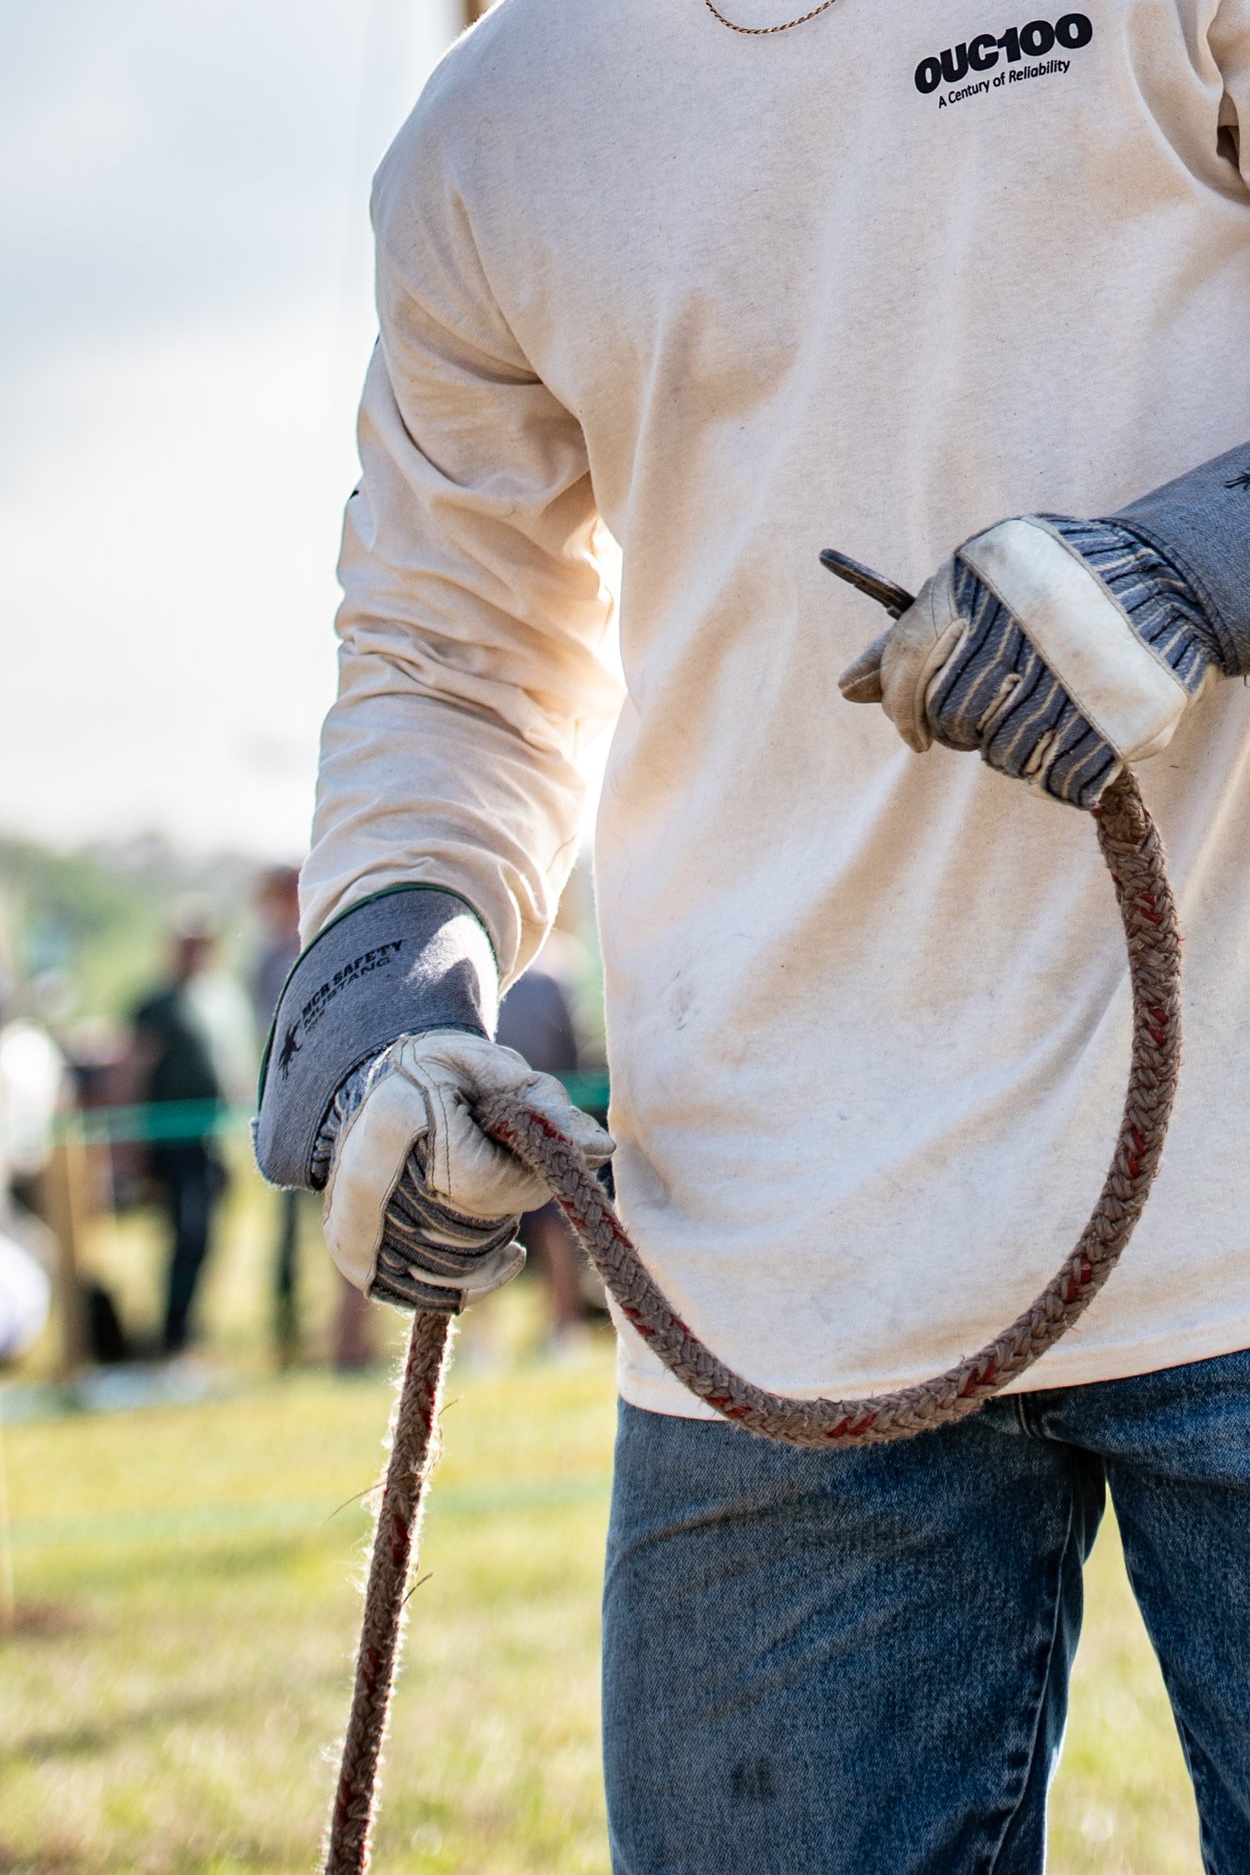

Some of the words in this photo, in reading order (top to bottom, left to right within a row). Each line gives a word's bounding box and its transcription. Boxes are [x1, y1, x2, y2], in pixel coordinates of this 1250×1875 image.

[939, 96, 947, 109] A
[948, 79, 990, 104] Century
[993, 72, 1006, 87] of
[1008, 59, 1071, 83] Reliability
[302, 982, 330, 1020] MCR
[332, 939, 404, 986] SAFETY
[303, 957, 391, 1028] MUSTANG
